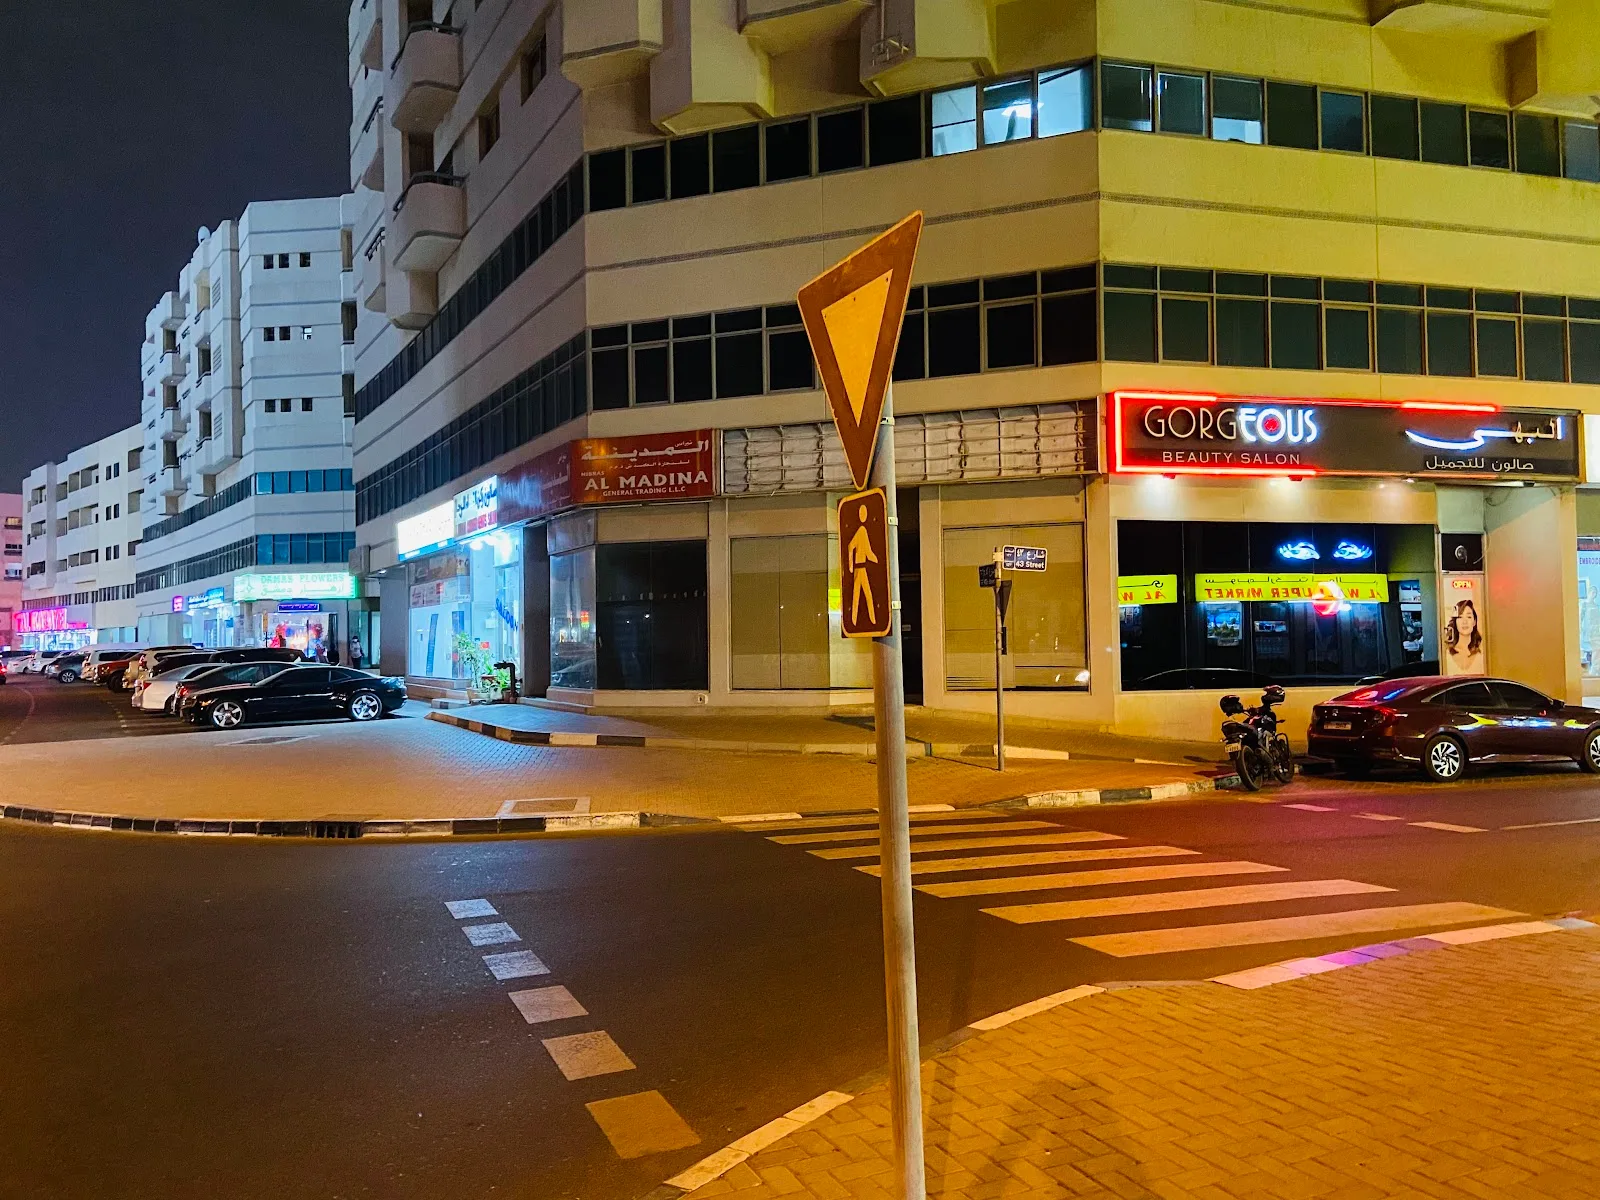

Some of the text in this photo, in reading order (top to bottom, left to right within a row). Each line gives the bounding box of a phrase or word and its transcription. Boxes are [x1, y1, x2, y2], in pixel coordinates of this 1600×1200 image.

[1144, 405, 1318, 443] GORGEOUS
[580, 439, 709, 463] المدينة
[1162, 451, 1300, 465] BEAUTY SALON
[1425, 456, 1534, 472] صالون للتجميل
[584, 470, 708, 491] AL MADINA
[603, 489, 633, 497] GENERAL
[635, 487, 667, 495] TRADING
[1015, 560, 1025, 568] 43
[1025, 561, 1045, 569] Street
